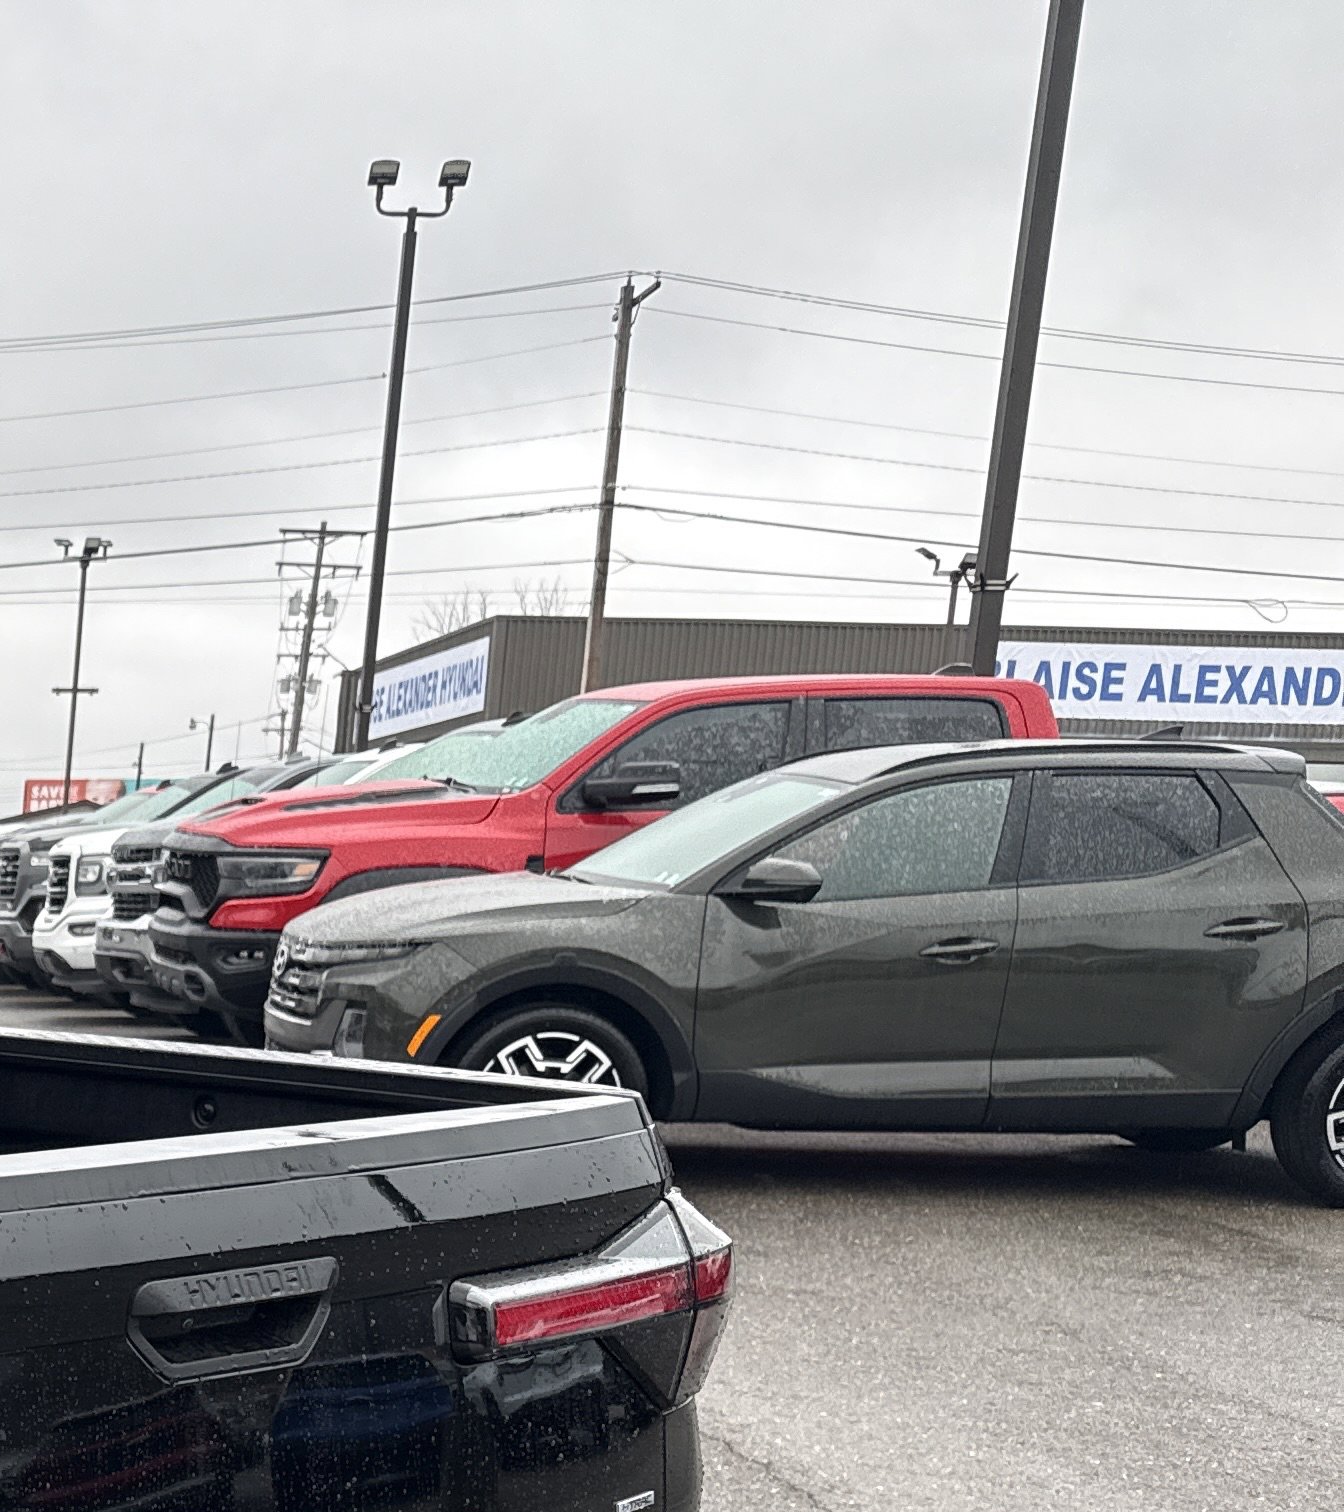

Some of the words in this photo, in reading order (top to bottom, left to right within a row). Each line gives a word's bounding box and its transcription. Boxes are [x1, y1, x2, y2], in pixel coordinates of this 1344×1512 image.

[385, 669, 439, 720] ALEXANDER
[439, 655, 485, 706] HYUNDAI
[994, 660, 1127, 702] AISE
[1136, 663, 1344, 707] ALEXAND
[180, 1263, 314, 1310] HYUNDAI
